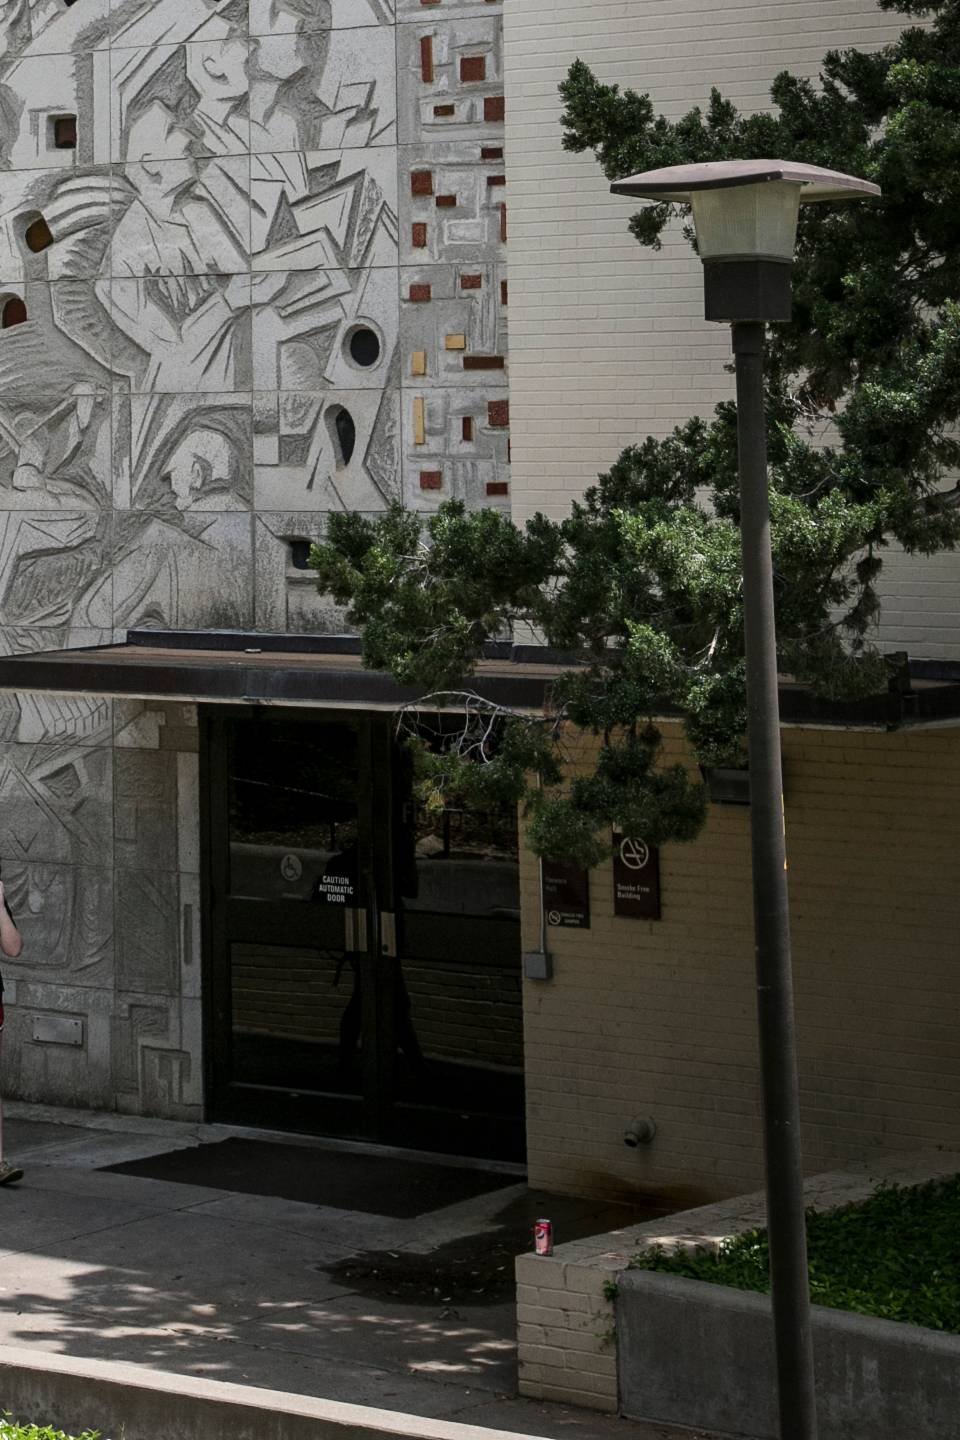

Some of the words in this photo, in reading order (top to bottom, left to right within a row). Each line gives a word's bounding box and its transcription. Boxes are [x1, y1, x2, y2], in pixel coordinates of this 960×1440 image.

[322, 875, 349, 885] CAUTION
[319, 884, 354, 895] AUTOMATIC
[616, 882, 636, 892] Smoke
[637, 884, 651, 893] Free
[327, 893, 346, 903] DOOR
[616, 891, 641, 901] Building
